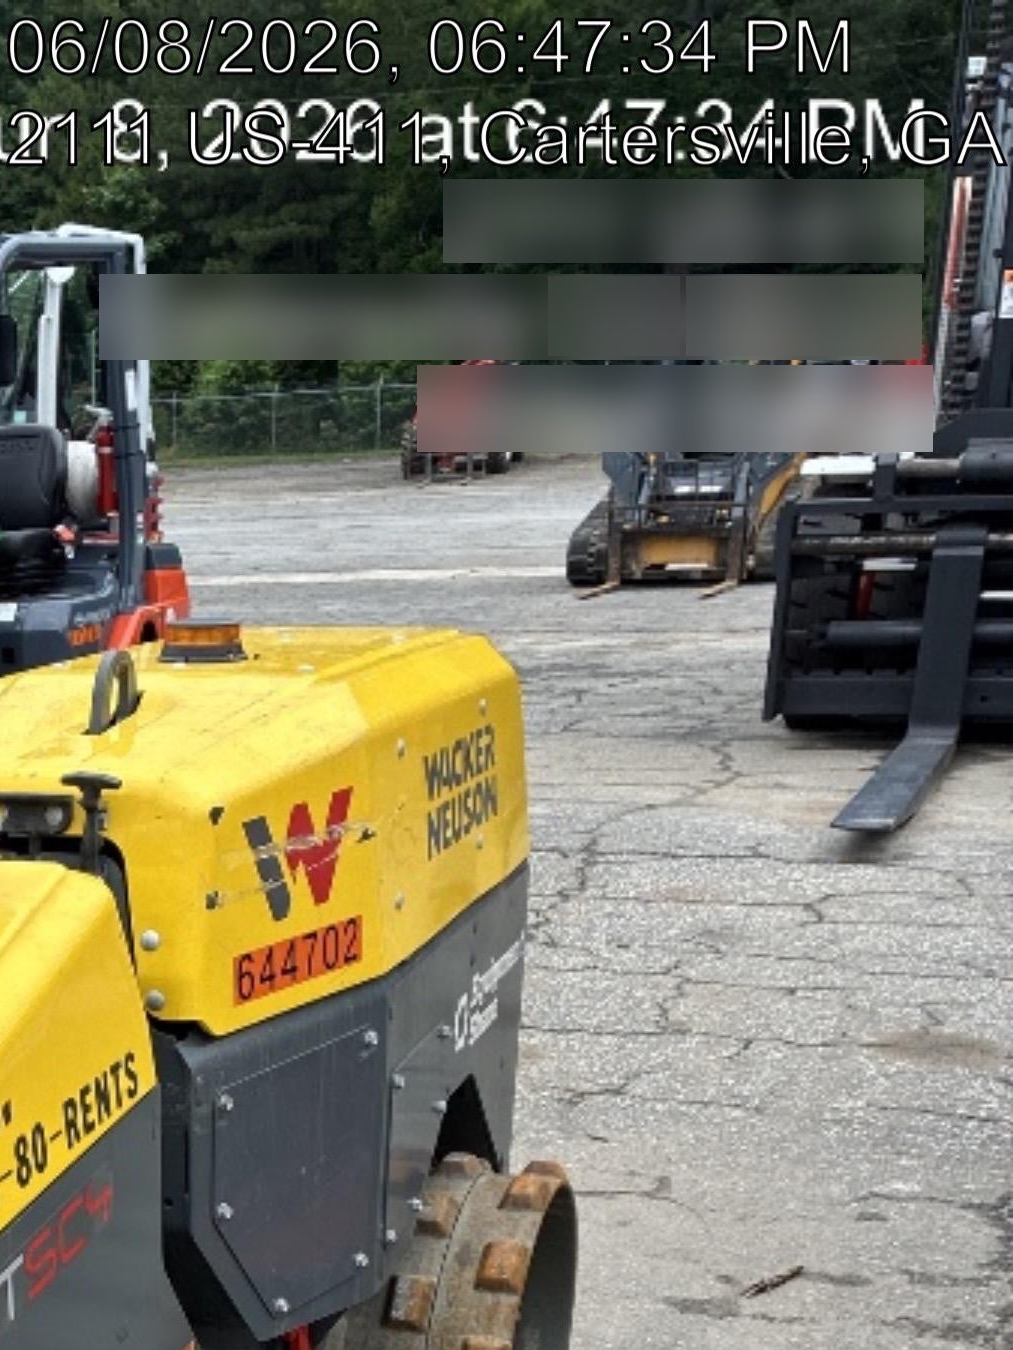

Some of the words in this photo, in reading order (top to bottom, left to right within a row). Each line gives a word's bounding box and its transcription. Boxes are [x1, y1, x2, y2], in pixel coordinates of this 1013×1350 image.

[422, 723, 495, 801] WACKER
[428, 773, 498, 862] NEUSON
[237, 917, 360, 1001] 644702
